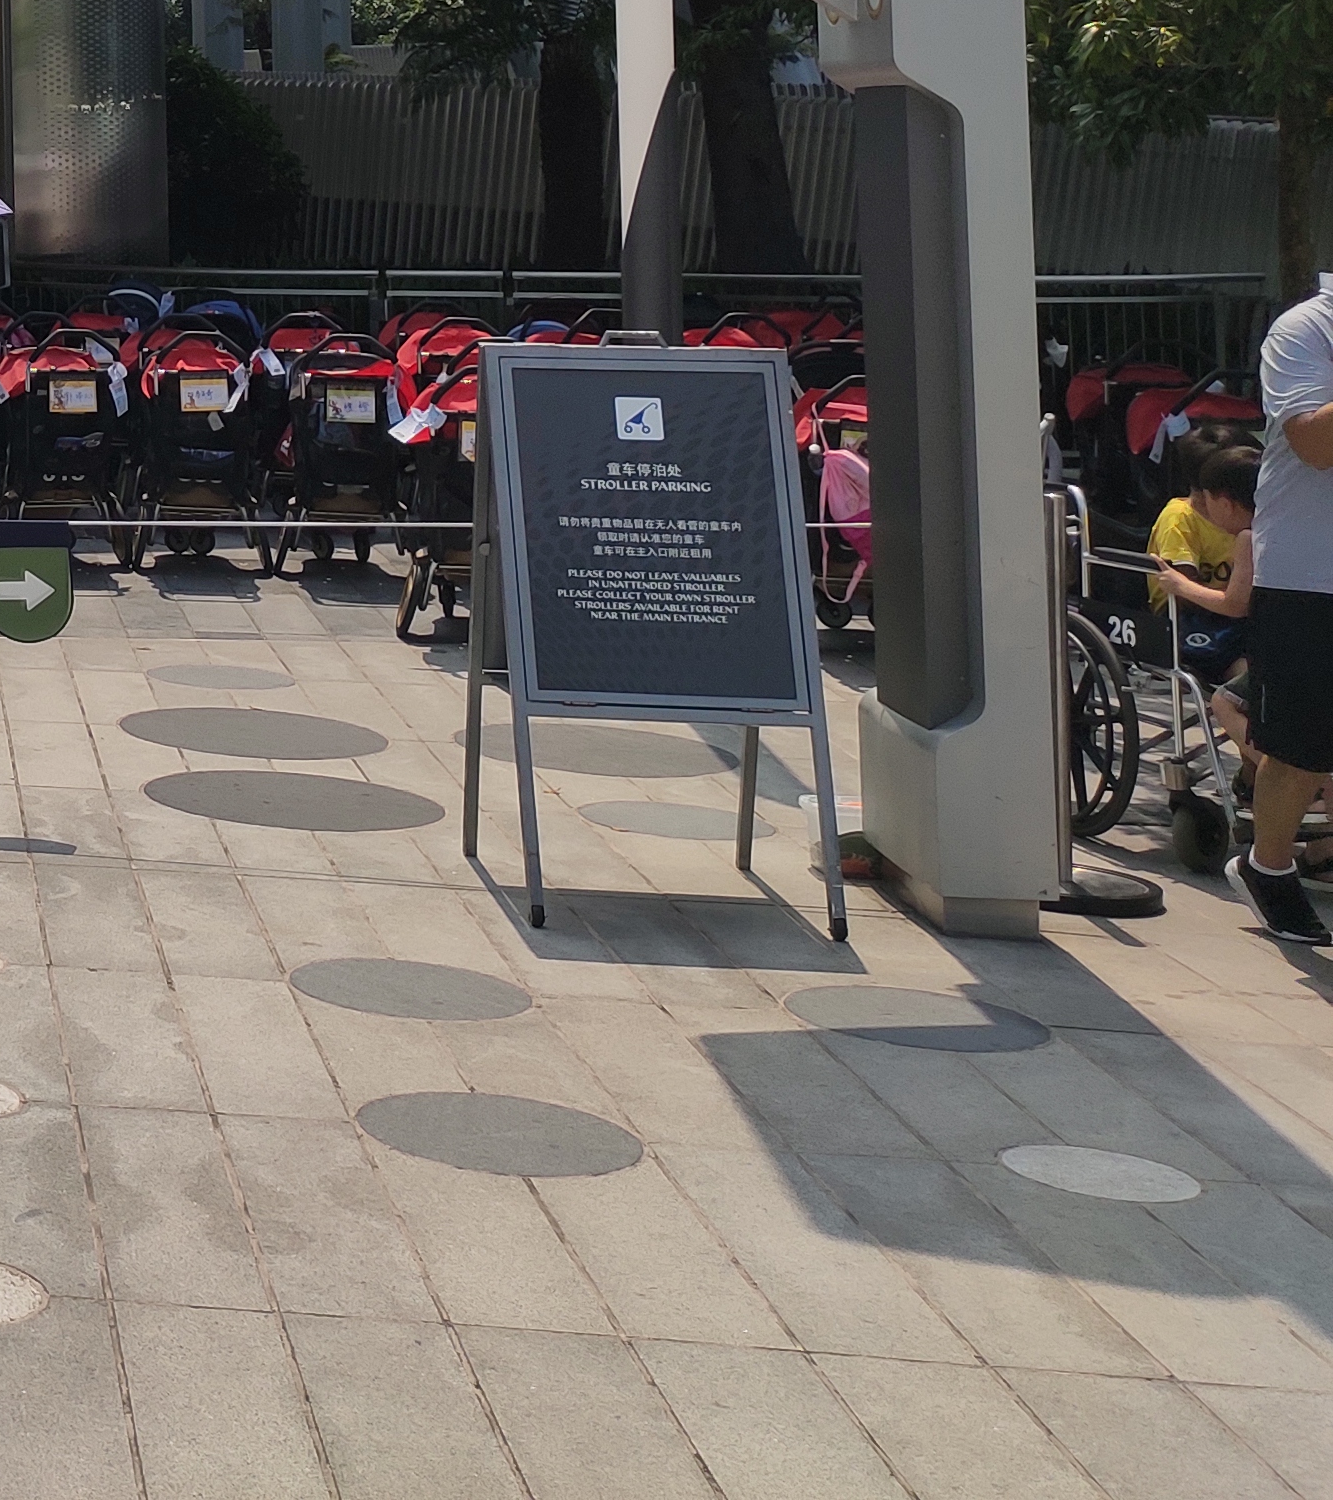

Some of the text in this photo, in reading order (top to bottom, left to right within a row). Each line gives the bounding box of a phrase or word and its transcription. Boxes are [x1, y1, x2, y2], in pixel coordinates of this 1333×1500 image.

[606, 462, 682, 477] 童车停泊处
[581, 478, 712, 493] STROLLER PARKING
[567, 568, 742, 583] PLEASE DO NOT LEAVE VALUABLES
[588, 580, 725, 592] IN UNATTENDED STROLLER
[557, 589, 756, 604] PLEASE COLLECT YOUR OWN STROLLER
[574, 600, 740, 614] STROLLERS AVAILABLE FOR RENT
[590, 611, 729, 624] NEAR THE MAIN ENTRANCE
[1107, 615, 1136, 648] 26
